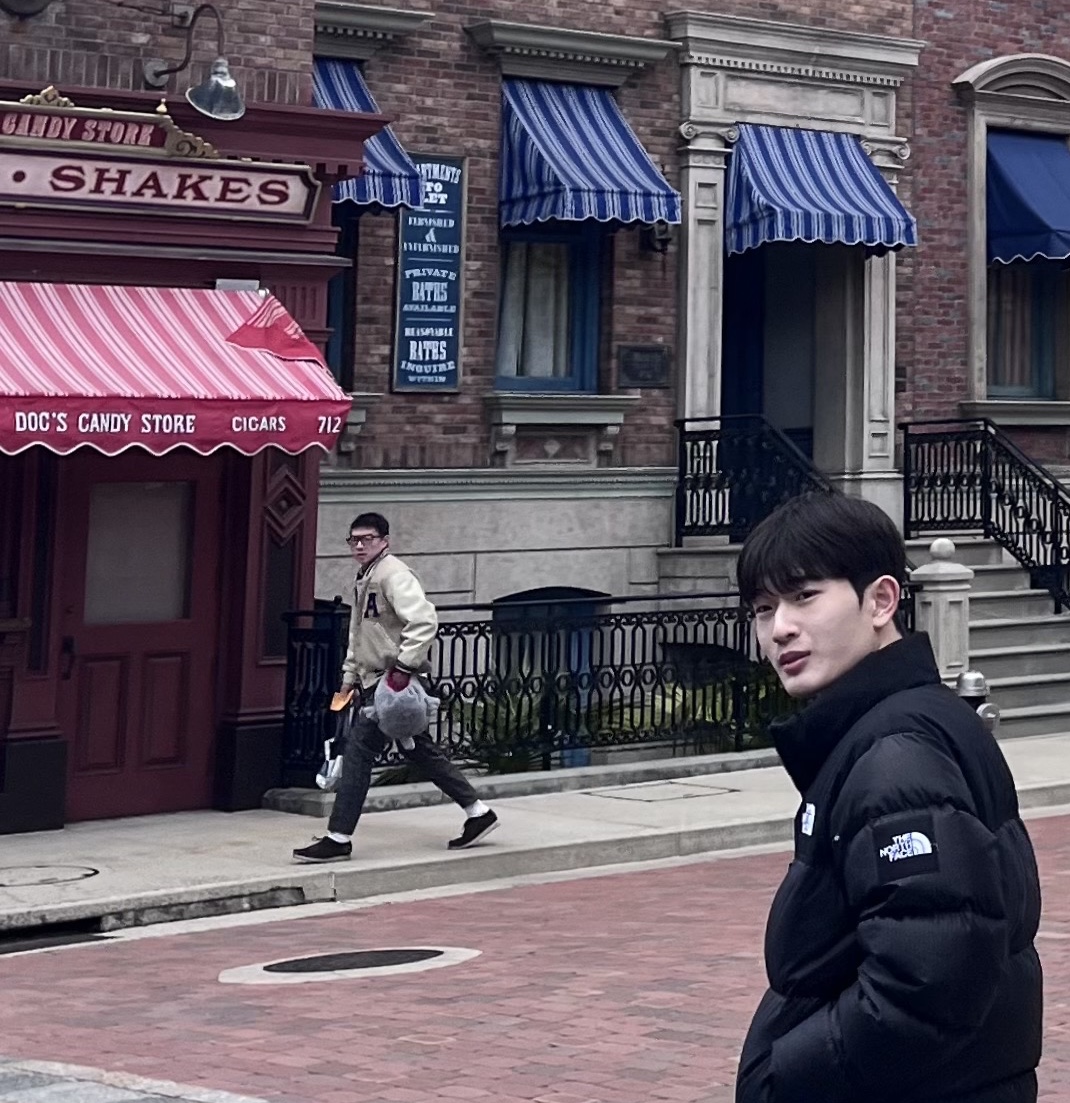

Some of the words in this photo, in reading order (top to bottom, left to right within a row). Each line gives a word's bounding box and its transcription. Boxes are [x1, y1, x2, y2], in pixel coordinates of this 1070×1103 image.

[1, 113, 77, 139] CANDY
[82, 119, 154, 146] STORE
[50, 165, 290, 205] SHAKES
[424, 181, 443, 192] TO
[408, 216, 455, 228] FURNISHED
[425, 227, 437, 243] &
[403, 242, 460, 254] UNFURNISHED
[404, 267, 457, 281] PRIVATE
[412, 281, 448, 302] BATHS
[402, 304, 456, 313] AVAILABLE
[404, 327, 454, 337] REASONABLE
[409, 340, 447, 361] RATES
[400, 360, 456, 374] INQUIRE
[408, 375, 446, 383] WITHIN
[15, 411, 68, 433] DOC'S
[78, 412, 132, 433] CANDY
[141, 414, 196, 433] STORE
[231, 416, 286, 431] CIGARS
[317, 416, 342, 433] 712
[364, 593, 380, 618] A
[892, 833, 912, 845] THE
[880, 841, 912, 858] NORTH
[889, 849, 914, 862] FACE
